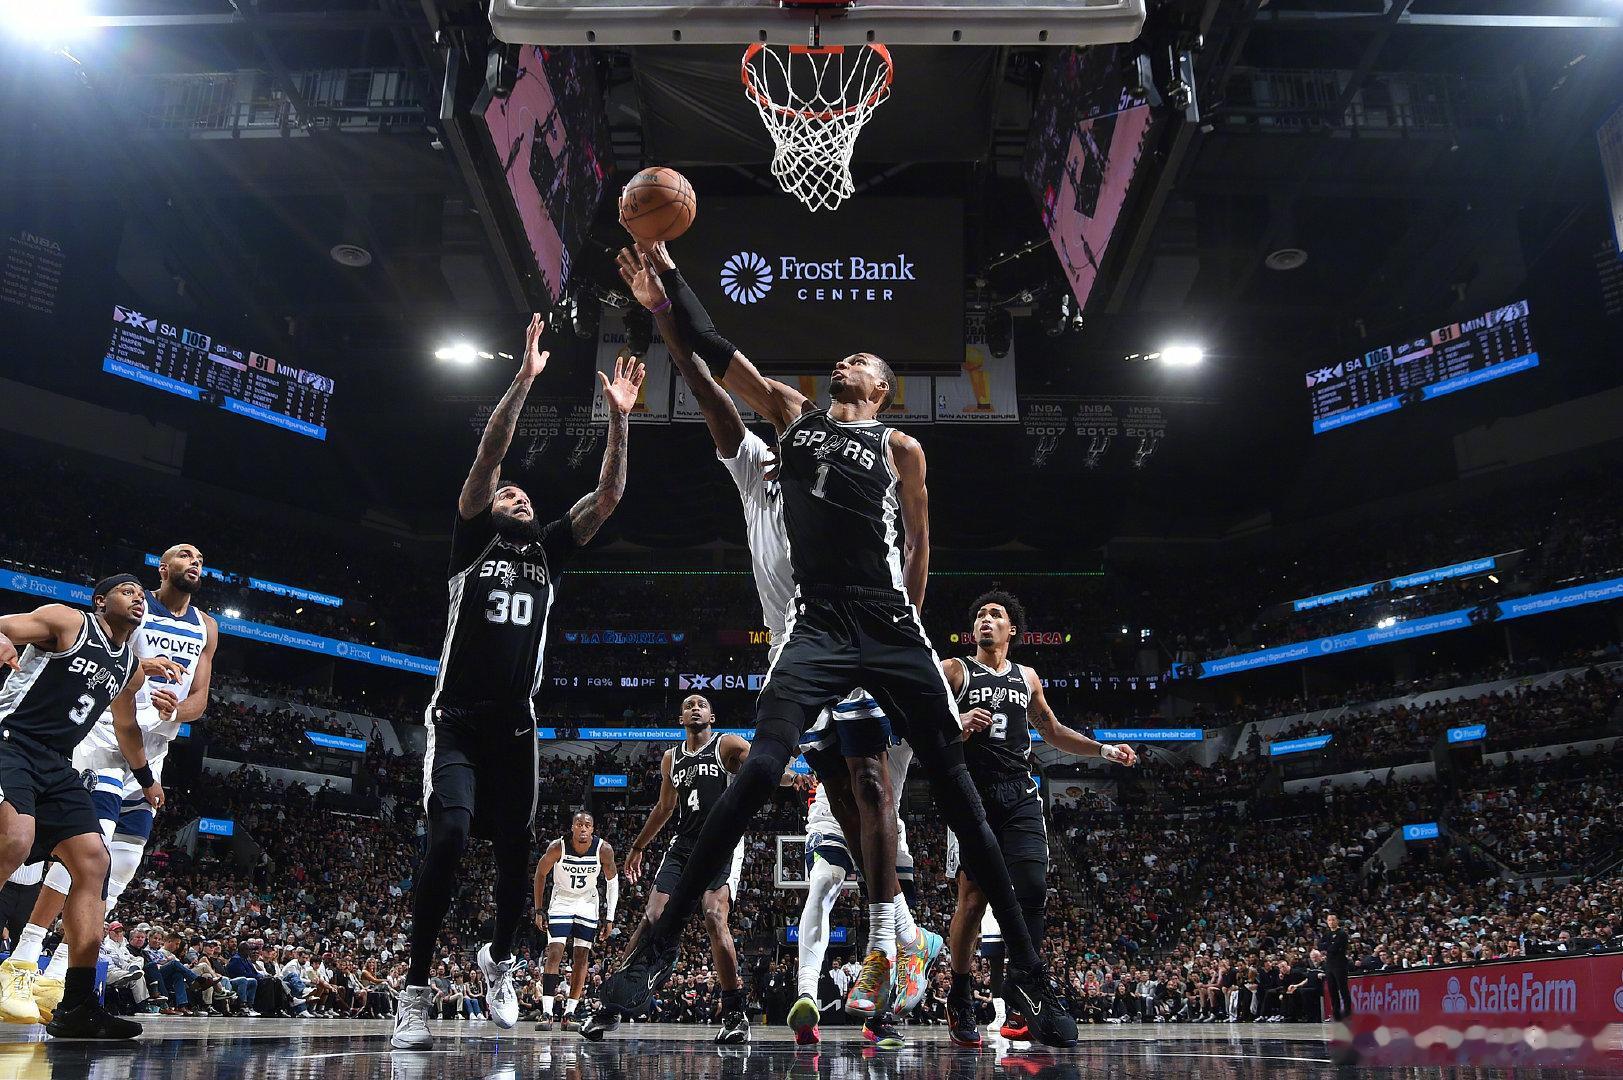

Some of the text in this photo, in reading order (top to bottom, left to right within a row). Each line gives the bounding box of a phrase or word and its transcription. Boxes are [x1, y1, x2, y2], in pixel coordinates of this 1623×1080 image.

[779, 253, 916, 280] Frost Bank
[797, 289, 893, 300] CENTER
[161, 324, 298, 379] SA 106 91 MIN
[1345, 358, 1363, 372] SA
[1369, 347, 1389, 366] 106
[1460, 316, 1486, 334] MIN
[111, 363, 135, 377] Where
[519, 428, 559, 436] 2003
[565, 428, 606, 436] 2005
[1026, 427, 1066, 435] 2007
[1077, 427, 1118, 436] 2013
[1126, 429, 1165, 438] 2014
[792, 429, 876, 470] SPURS
[811, 464, 830, 499] 1
[1473, 560, 1491, 570] Card
[29, 579, 57, 596] Frost
[485, 589, 534, 626] 30
[580, 630, 668, 644] LA GLORIA
[145, 634, 201, 657] WOLVES
[219, 621, 325, 650] FrostBank.com/SpursCard
[350, 646, 371, 660] Frost
[380, 653, 404, 666] Where
[403, 658, 420, 669] fans
[1211, 646, 1309, 673] FrostBank.com/SpursCard
[1332, 637, 1357, 649] Frost
[1366, 629, 1395, 642] Where
[1440, 617, 1463, 627] more
[553, 678, 568, 687] TO
[573, 677, 579, 687] 3
[587, 677, 613, 687] FG%
[620, 677, 639, 687] 50.0
[641, 678, 656, 687] PF
[664, 677, 669, 687] 3
[724, 675, 745, 689] SA
[1053, 679, 1080, 688] TO 3
[968, 686, 1028, 710] SPURS
[68, 693, 95, 726] 3
[990, 713, 1008, 740] 2
[602, 731, 622, 739] Spurs
[1117, 731, 1137, 739] Spurs
[607, 777, 622, 785] Frost
[673, 763, 719, 788] SPURS
[687, 789, 700, 811] 4
[209, 823, 227, 832] Frost
[562, 865, 597, 874] WOLVES
[570, 875, 587, 889] 13
[1350, 982, 1419, 1014] StateFarm
[1469, 972, 1577, 1014] StateFarm
